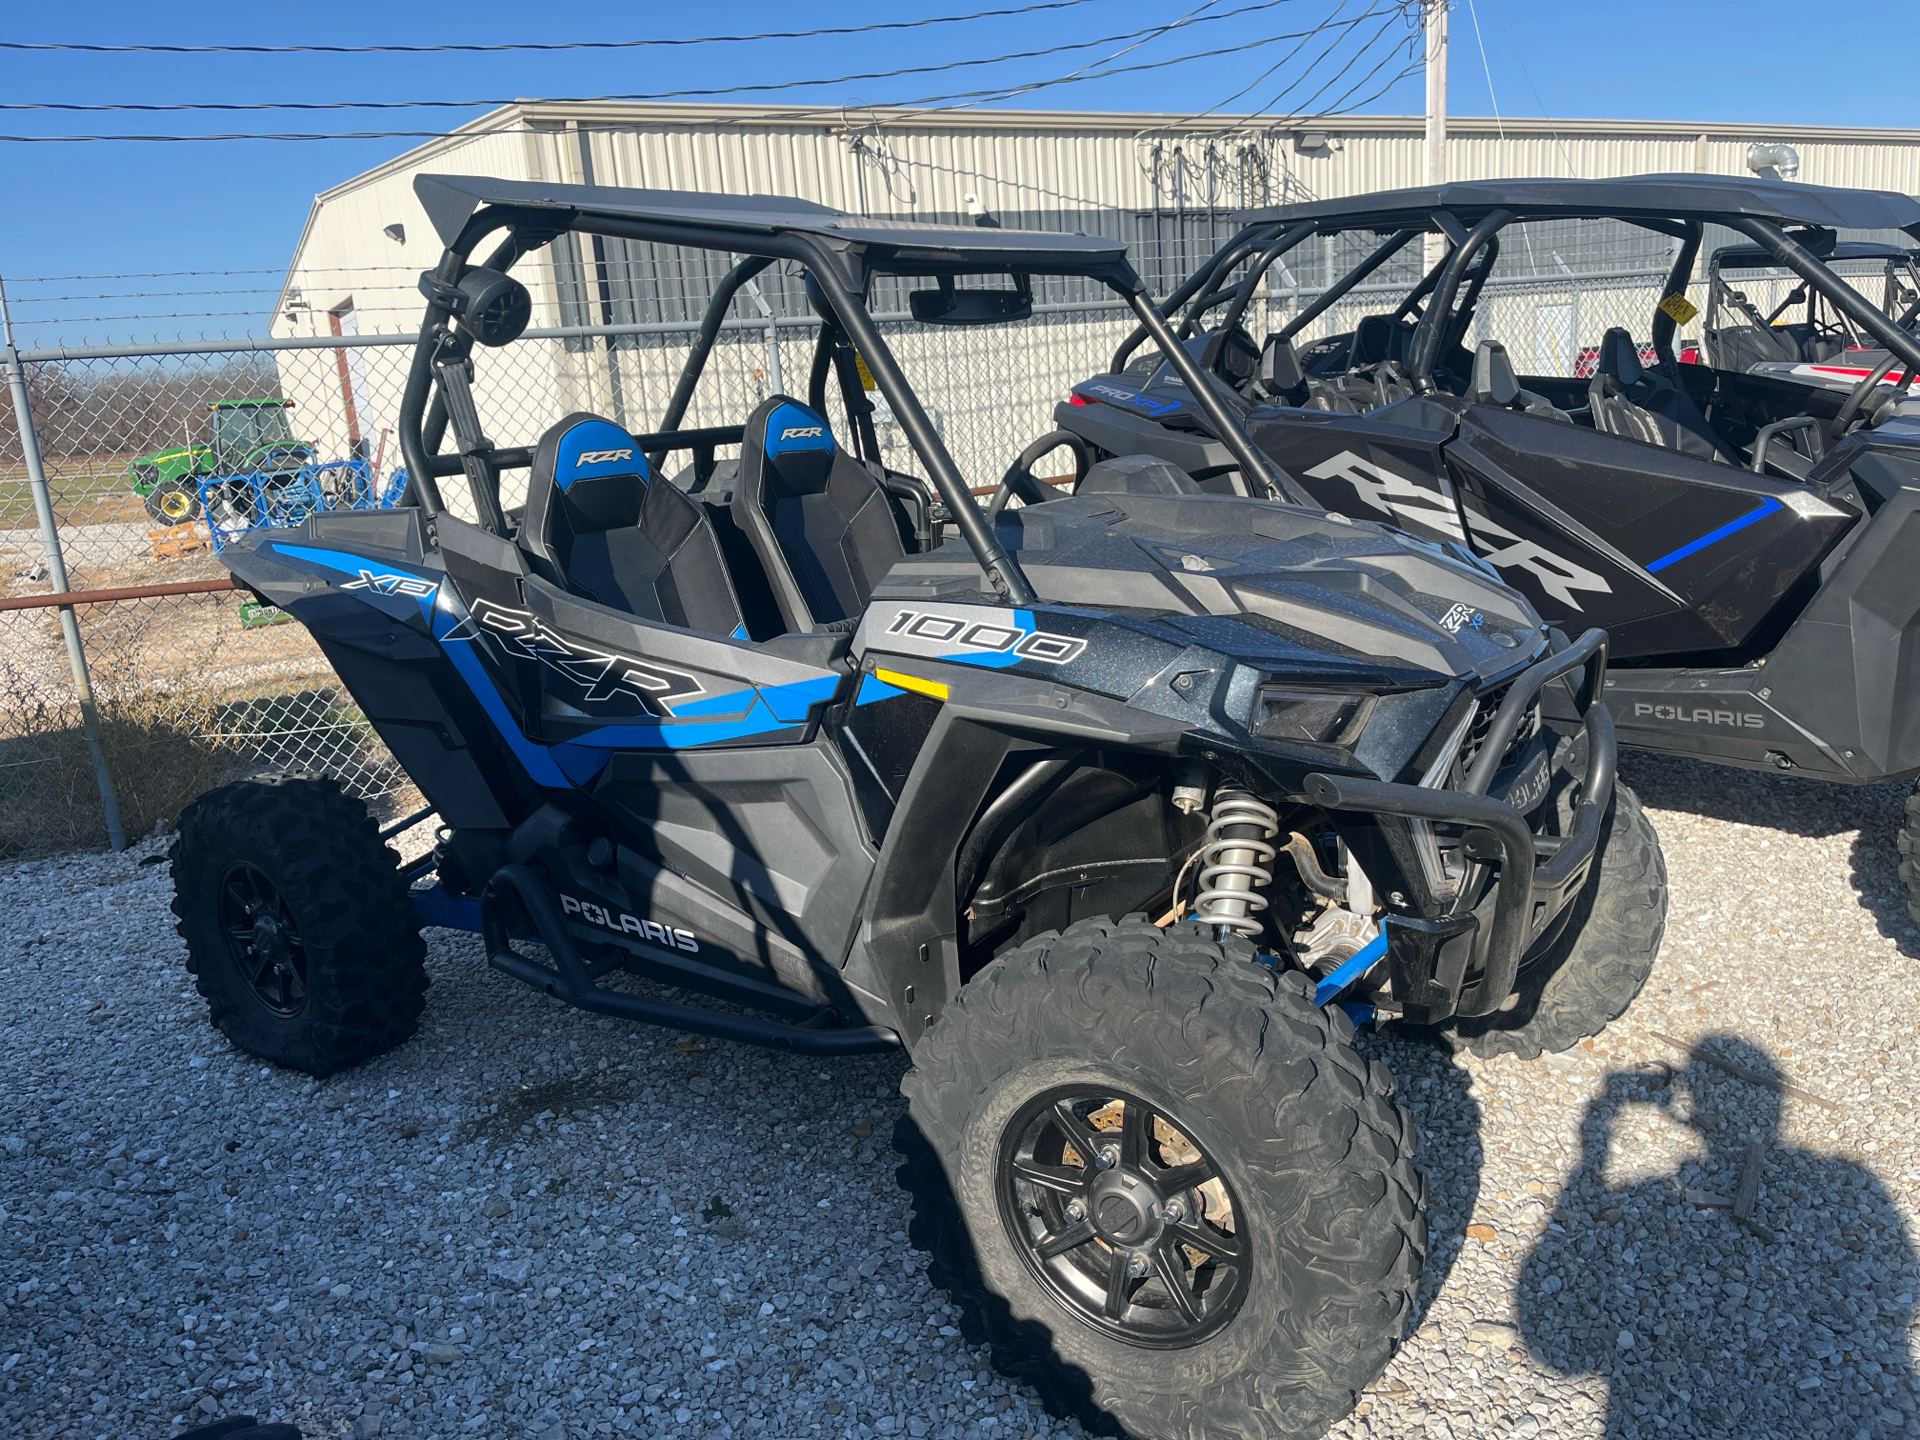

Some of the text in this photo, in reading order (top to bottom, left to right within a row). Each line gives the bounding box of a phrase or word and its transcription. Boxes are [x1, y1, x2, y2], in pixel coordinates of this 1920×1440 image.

[1089, 385, 1163, 409] PRO XP
[780, 427, 823, 442] RZR
[575, 448, 632, 468] RZR
[1302, 450, 1613, 613] RZR
[340, 569, 439, 597] XP
[1469, 612, 1484, 630] XP
[885, 609, 1088, 665] 1000
[439, 598, 707, 717] RZR
[1634, 703, 1766, 729] POLARIS
[559, 893, 699, 953] POLARIS
